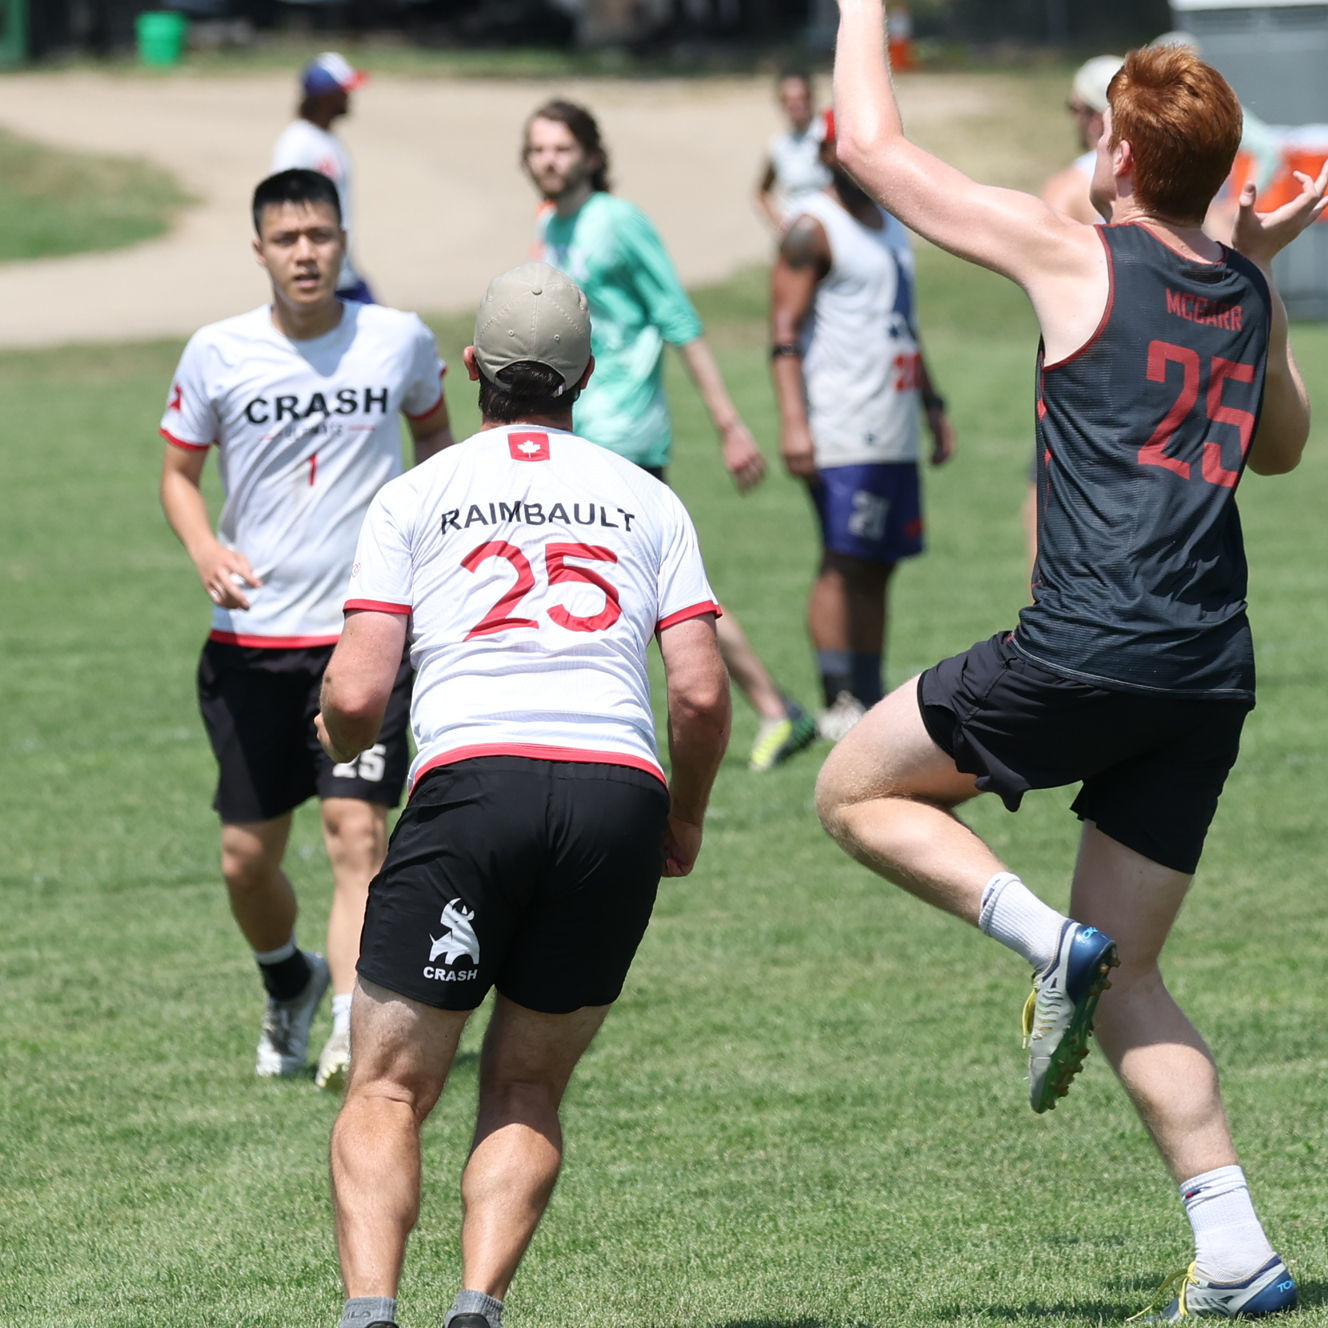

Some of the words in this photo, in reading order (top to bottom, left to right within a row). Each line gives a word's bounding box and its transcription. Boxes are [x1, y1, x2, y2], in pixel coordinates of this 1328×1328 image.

[1166, 288, 1244, 332] MCGARR
[244, 387, 389, 425] CRASH
[1137, 339, 1256, 488] 25
[440, 500, 636, 536] RAIMBAULT
[460, 539, 623, 643] 25
[423, 966, 479, 983] CRASH
